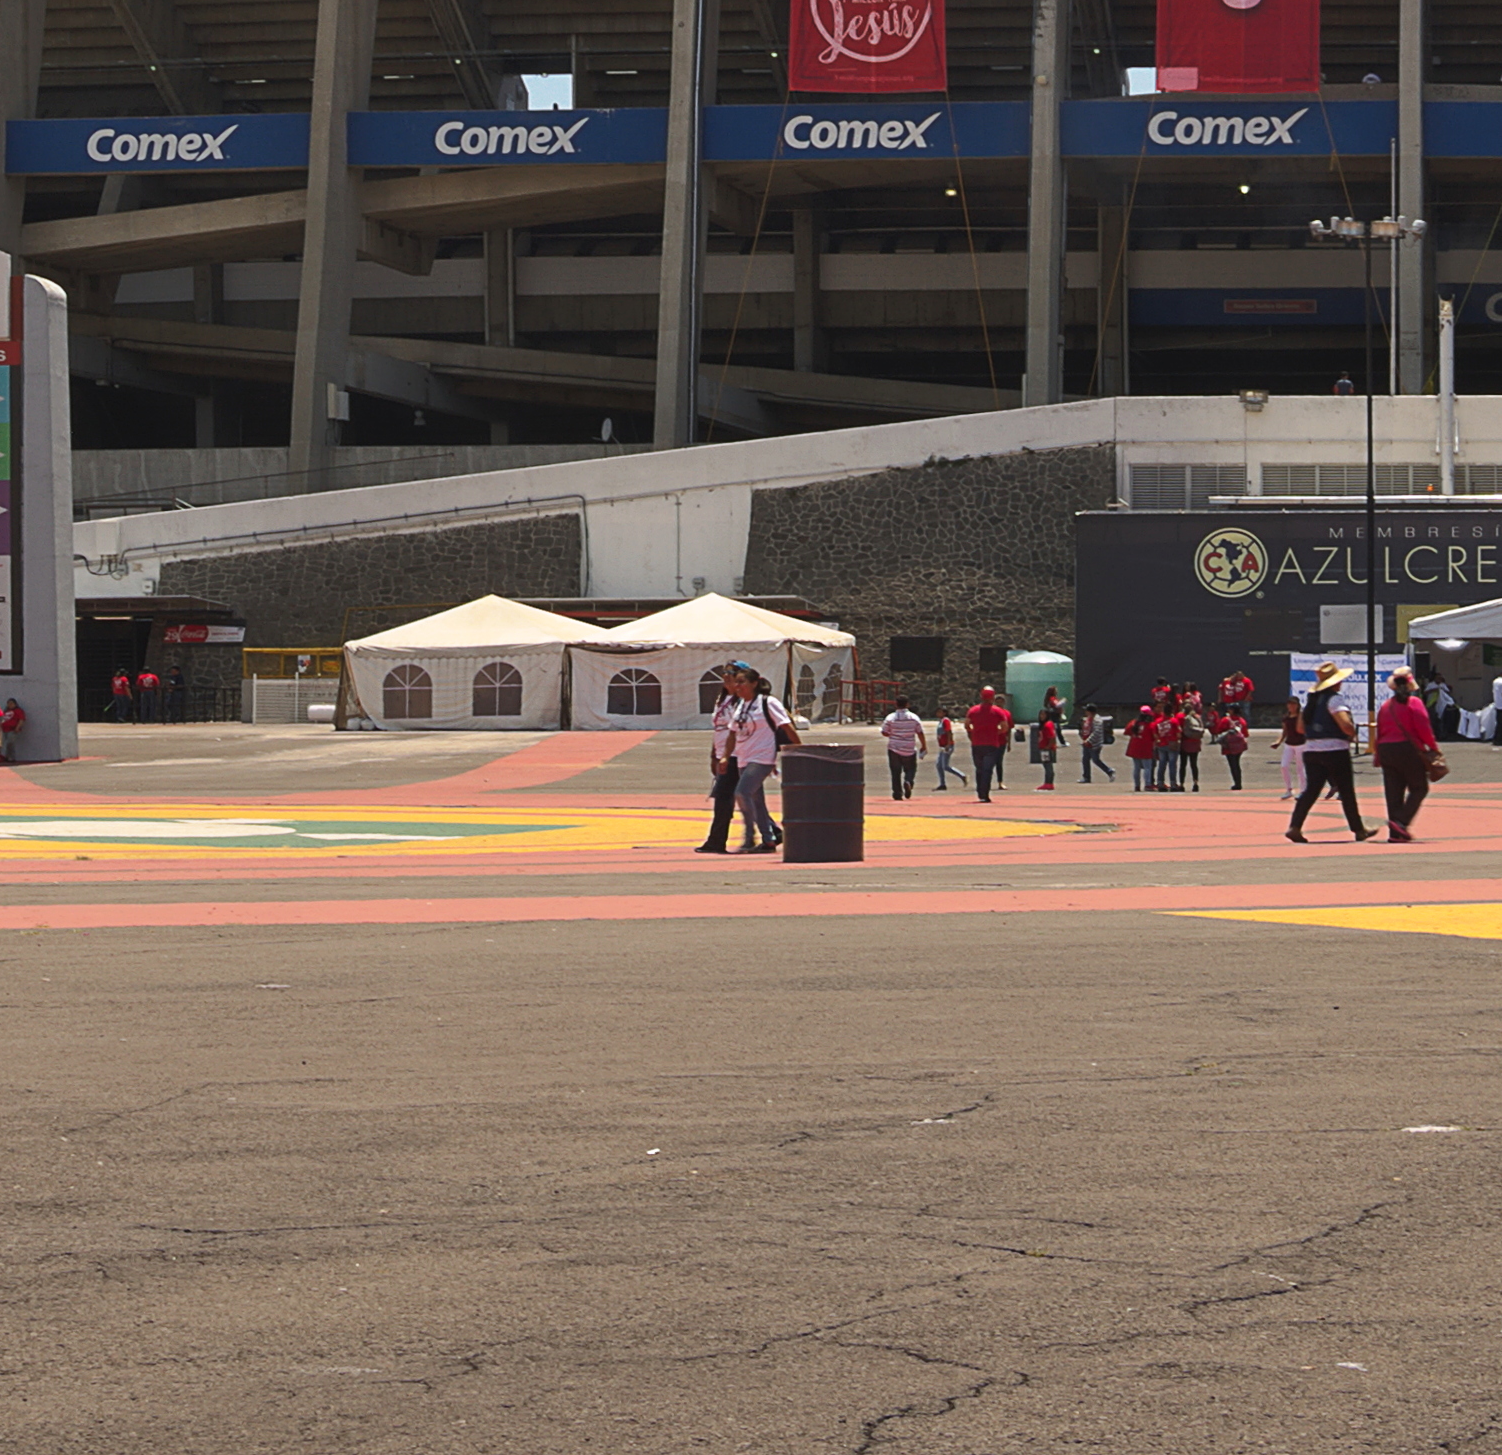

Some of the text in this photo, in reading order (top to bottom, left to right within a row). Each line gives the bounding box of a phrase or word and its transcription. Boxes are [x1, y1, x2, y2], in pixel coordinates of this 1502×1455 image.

[87, 124, 238, 162] Comex
[435, 117, 589, 155] Comex
[784, 112, 941, 150] Comex
[1148, 108, 1308, 146] Comex
